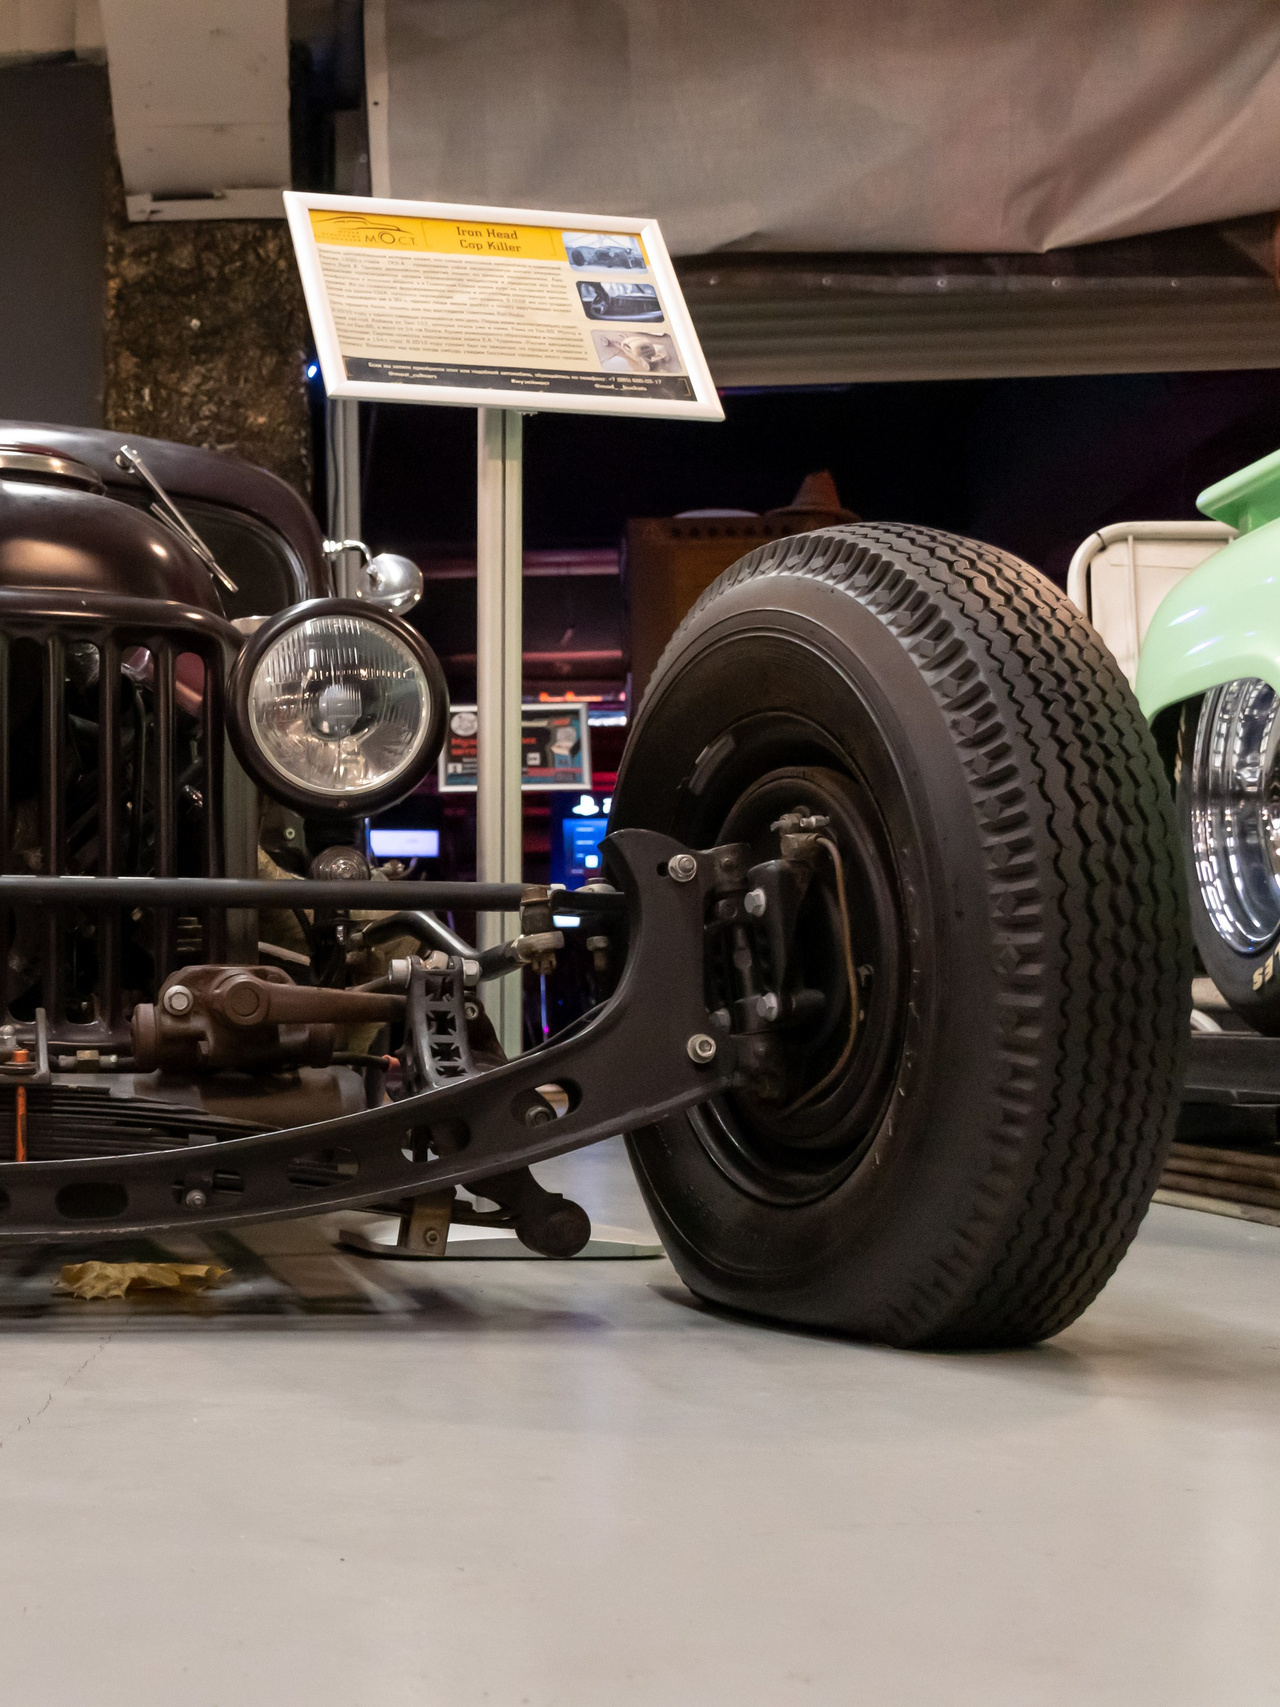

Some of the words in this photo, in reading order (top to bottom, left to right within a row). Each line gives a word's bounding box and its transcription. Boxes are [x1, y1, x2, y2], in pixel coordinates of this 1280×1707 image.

[456, 226, 483, 237] Iron
[486, 228, 519, 240] Head
[459, 239, 484, 251] Cop
[487, 241, 522, 252] Killer
